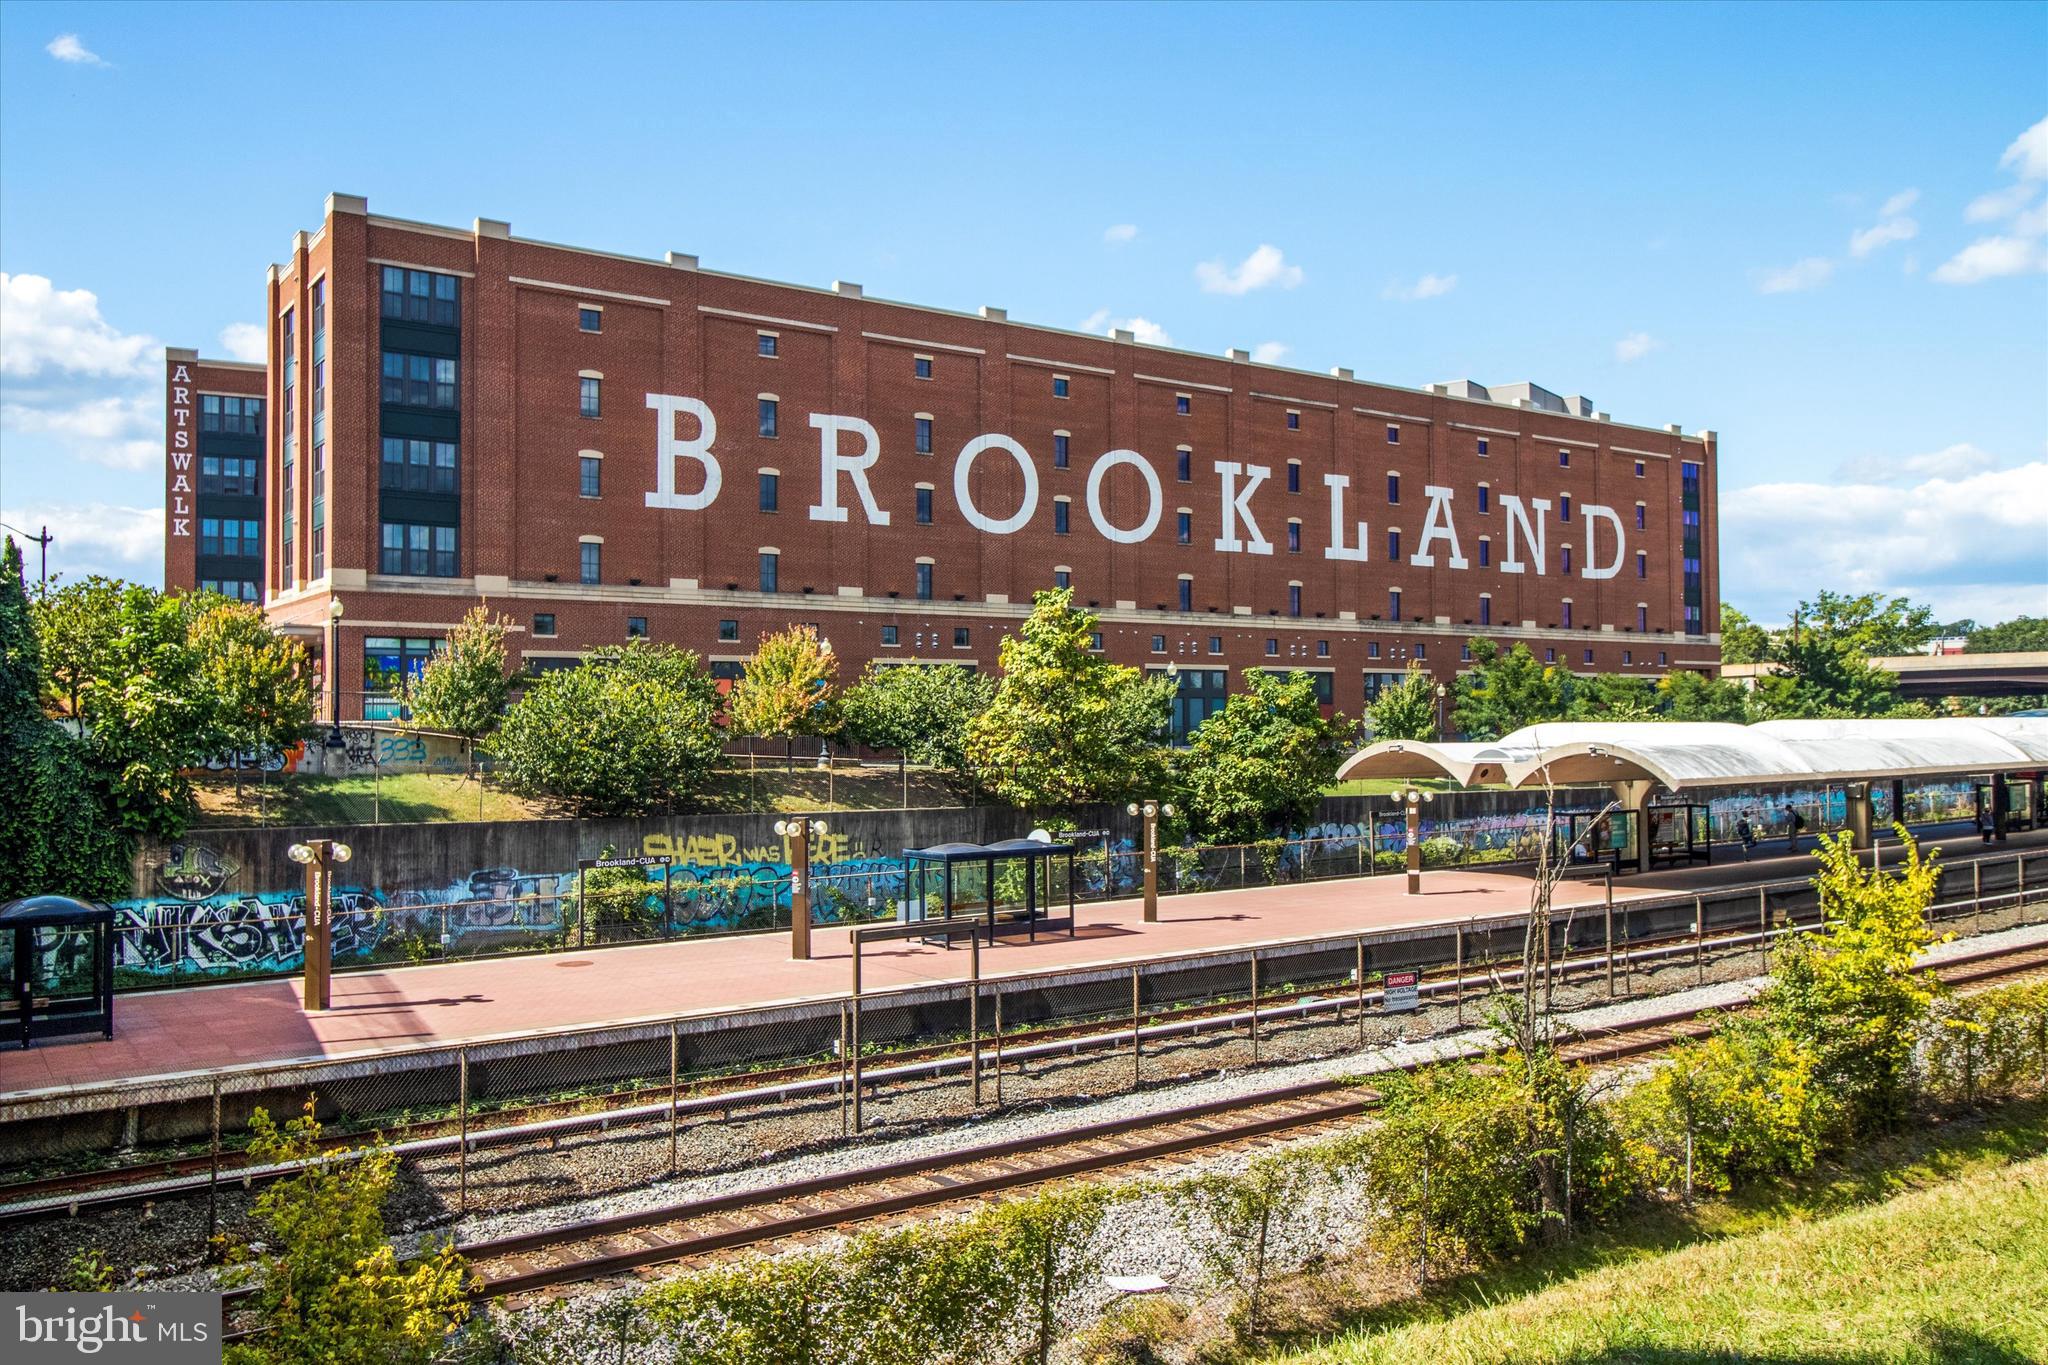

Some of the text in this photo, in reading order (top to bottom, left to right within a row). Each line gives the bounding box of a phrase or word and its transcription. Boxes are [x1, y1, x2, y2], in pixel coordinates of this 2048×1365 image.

[172, 365, 192, 536] ARTSWALK
[645, 393, 1625, 579] BROOKLAND
[595, 857, 656, 867] Brookland-CUA
[743, 846, 780, 863] WAS
[1388, 975, 1414, 985] DANGER
